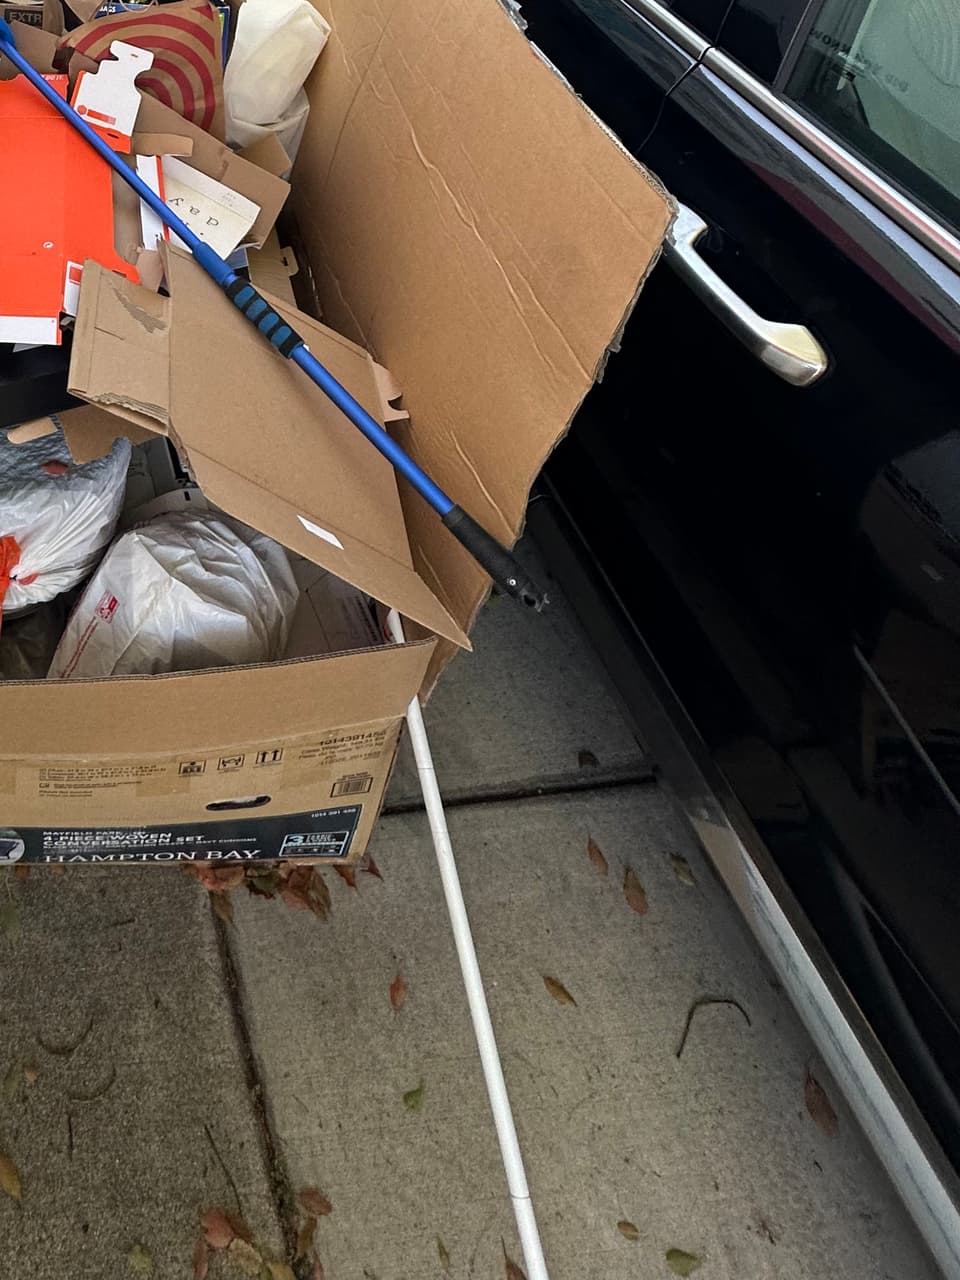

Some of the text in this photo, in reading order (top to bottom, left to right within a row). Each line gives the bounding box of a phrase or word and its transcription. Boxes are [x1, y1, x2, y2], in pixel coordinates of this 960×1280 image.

[43, 838, 171, 847] CONVERSATION
[176, 835, 205, 843] SET
[108, 832, 172, 841] WOVEN
[44, 851, 196, 863] HAMPTON
[206, 850, 262, 861] BAY
